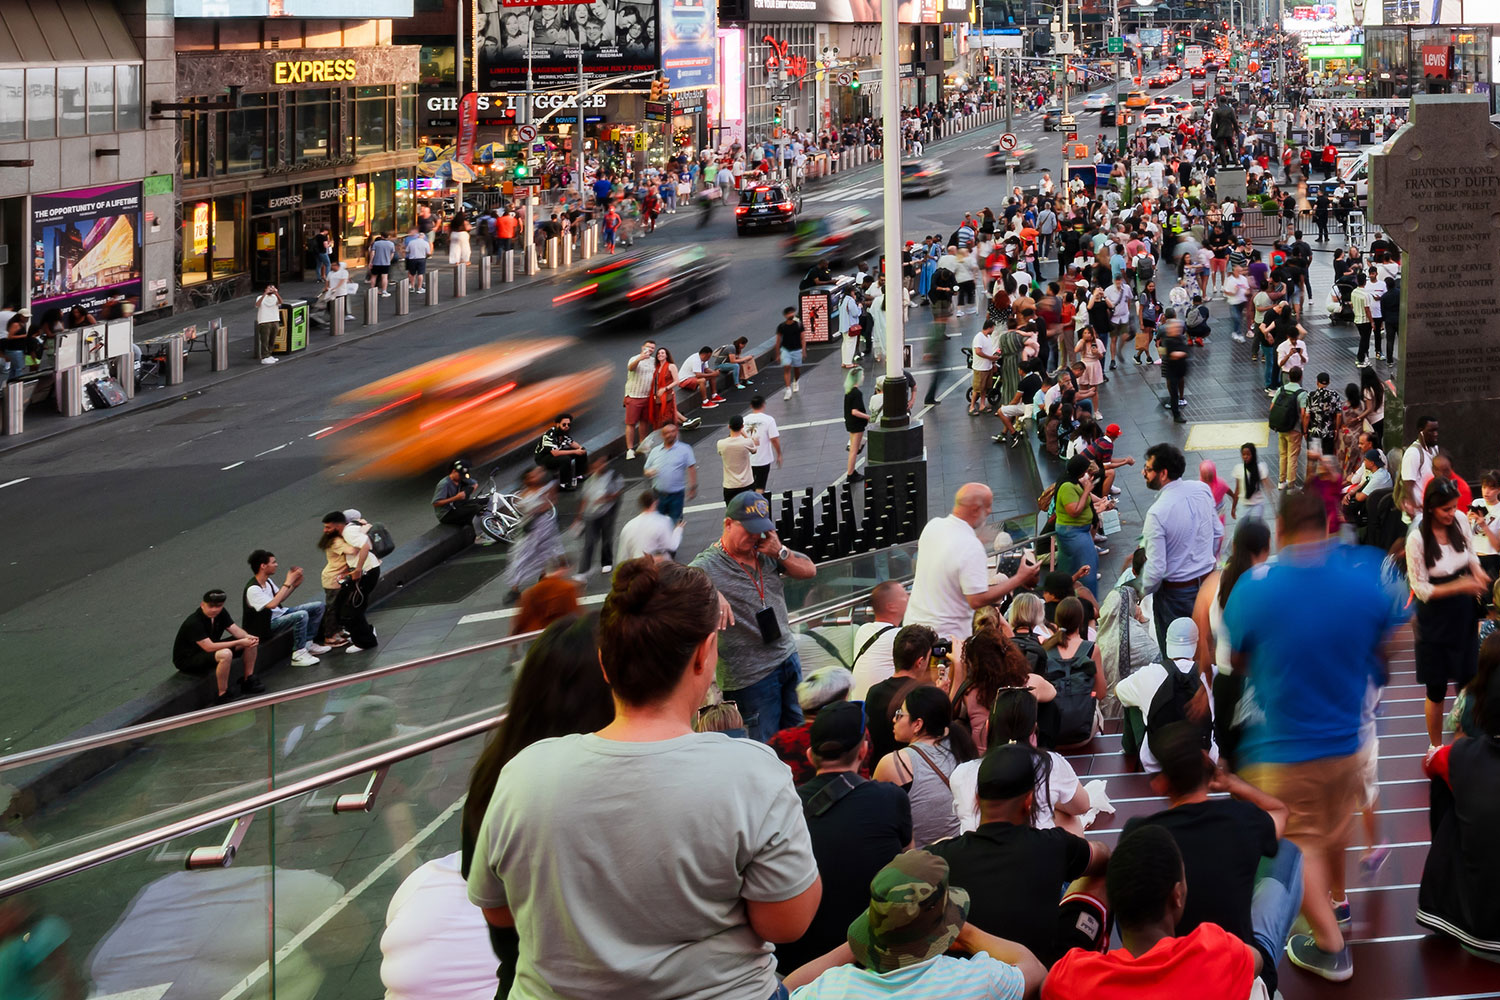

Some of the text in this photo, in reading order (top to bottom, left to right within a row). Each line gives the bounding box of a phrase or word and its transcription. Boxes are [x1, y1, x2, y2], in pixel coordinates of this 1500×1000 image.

[764, 0, 775, 8] YOUR
[275, 59, 357, 84] EXPRESS
[1411, 166, 1494, 177] LIEUTENANT COLONEL
[1405, 178, 1451, 190] FRANCIS
[269, 194, 302, 208] EXPRESS
[34, 196, 138, 219] THE OPPORTUNITY OF A LIFETIME
[1418, 202, 1490, 213] CATHOLIC PRIEST
[1435, 222, 1474, 232] CHAPLAIN
[1429, 265, 1444, 274] LIFE
[1447, 264, 1458, 273] OF
[1461, 263, 1492, 272] SERVICE
[1417, 278, 1495, 290] GOD AND COUNTRY
